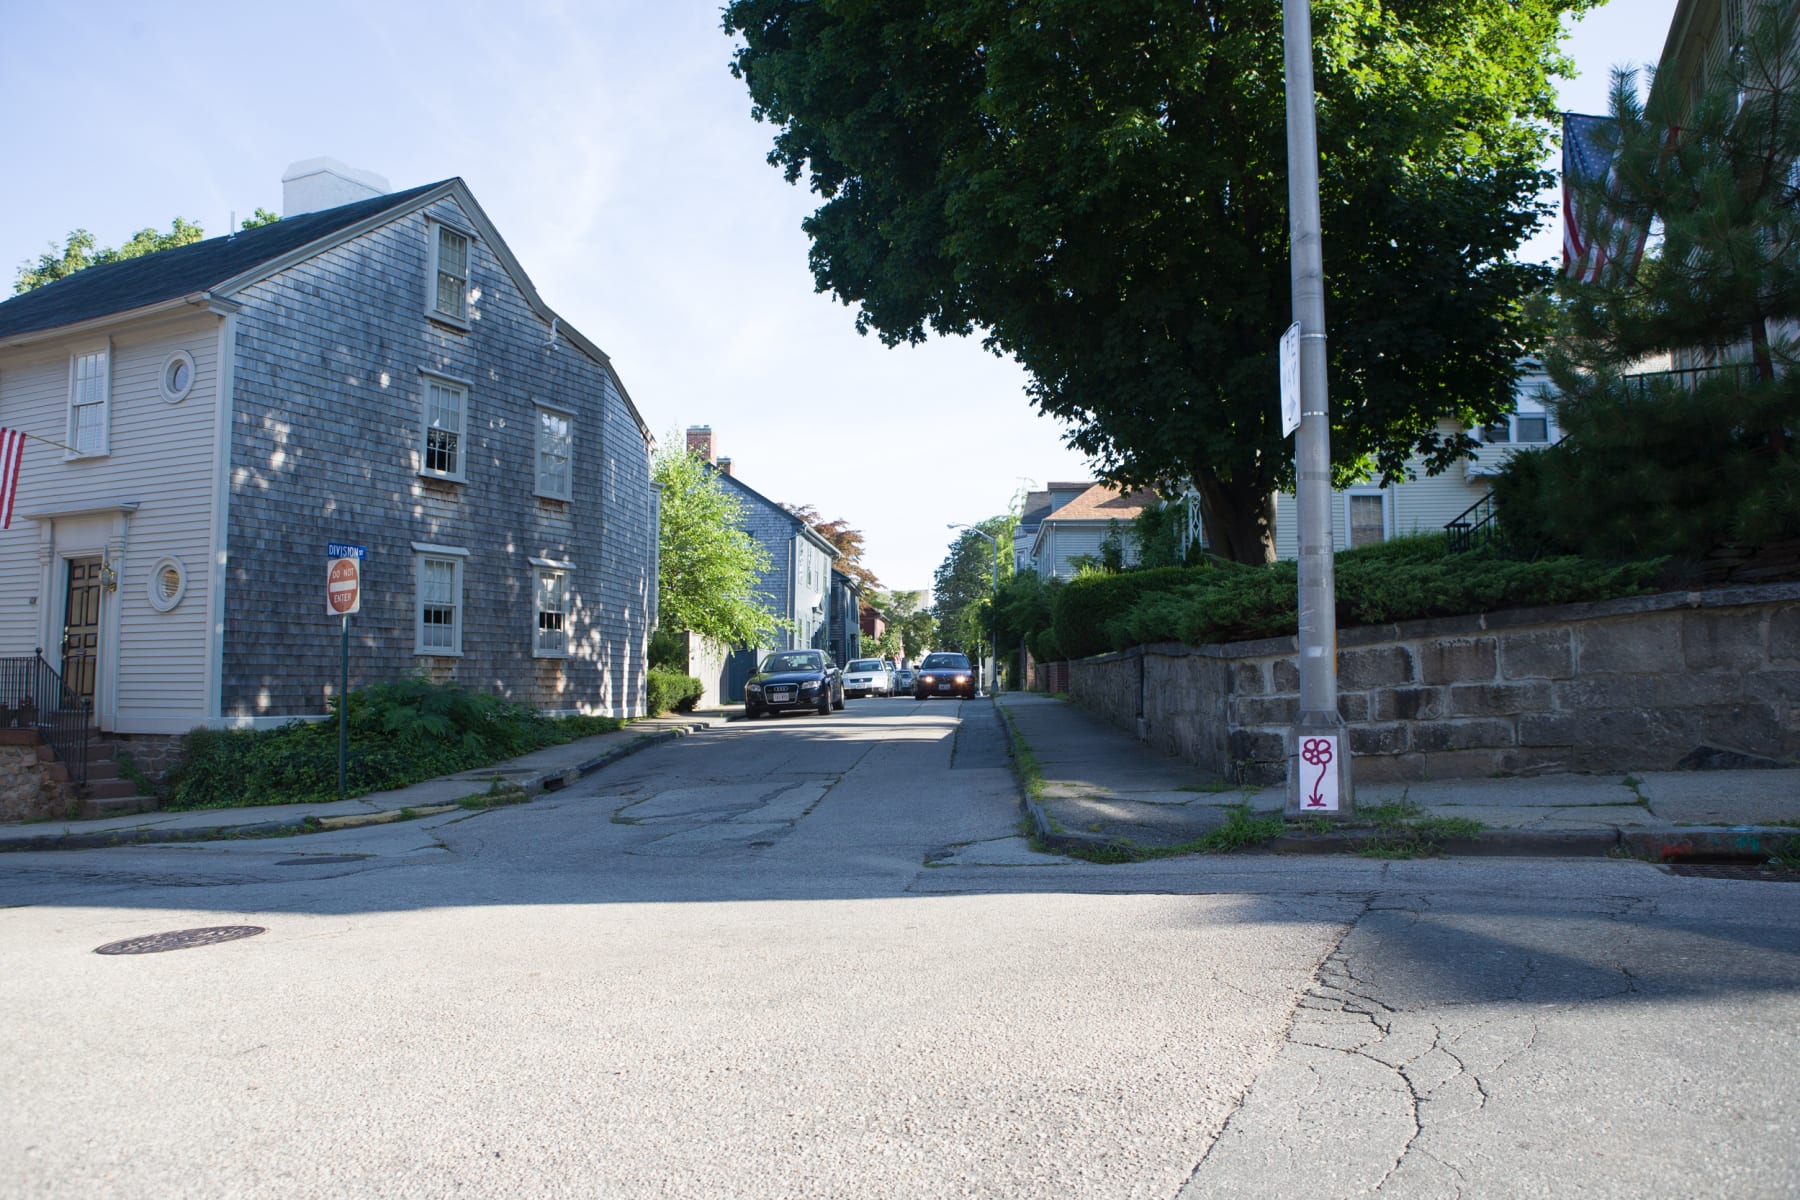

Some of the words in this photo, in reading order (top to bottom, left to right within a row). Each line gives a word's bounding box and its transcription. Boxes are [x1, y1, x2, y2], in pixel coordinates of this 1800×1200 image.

[328, 544, 358, 558] DIVISION
[332, 570, 340, 579] DO
[343, 567, 353, 576] NOT
[334, 593, 351, 603] ENTER
